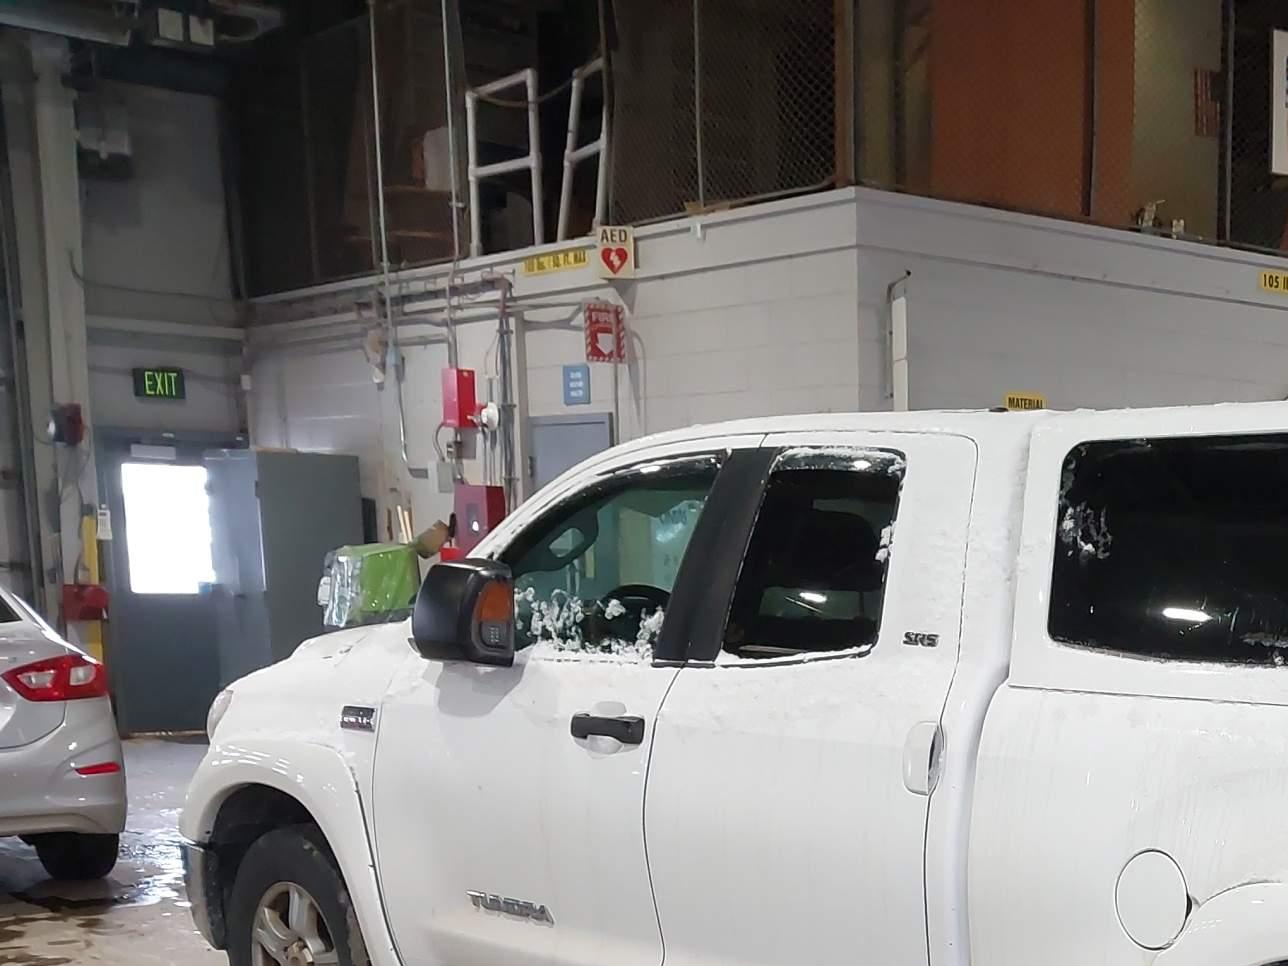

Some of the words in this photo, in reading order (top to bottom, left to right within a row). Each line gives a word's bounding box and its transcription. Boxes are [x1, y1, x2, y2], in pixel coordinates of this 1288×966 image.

[601, 229, 628, 243] AED
[1263, 273, 1280, 288] 105
[145, 371, 177, 396] EXIT
[466, 890, 554, 925] TUNDRA
